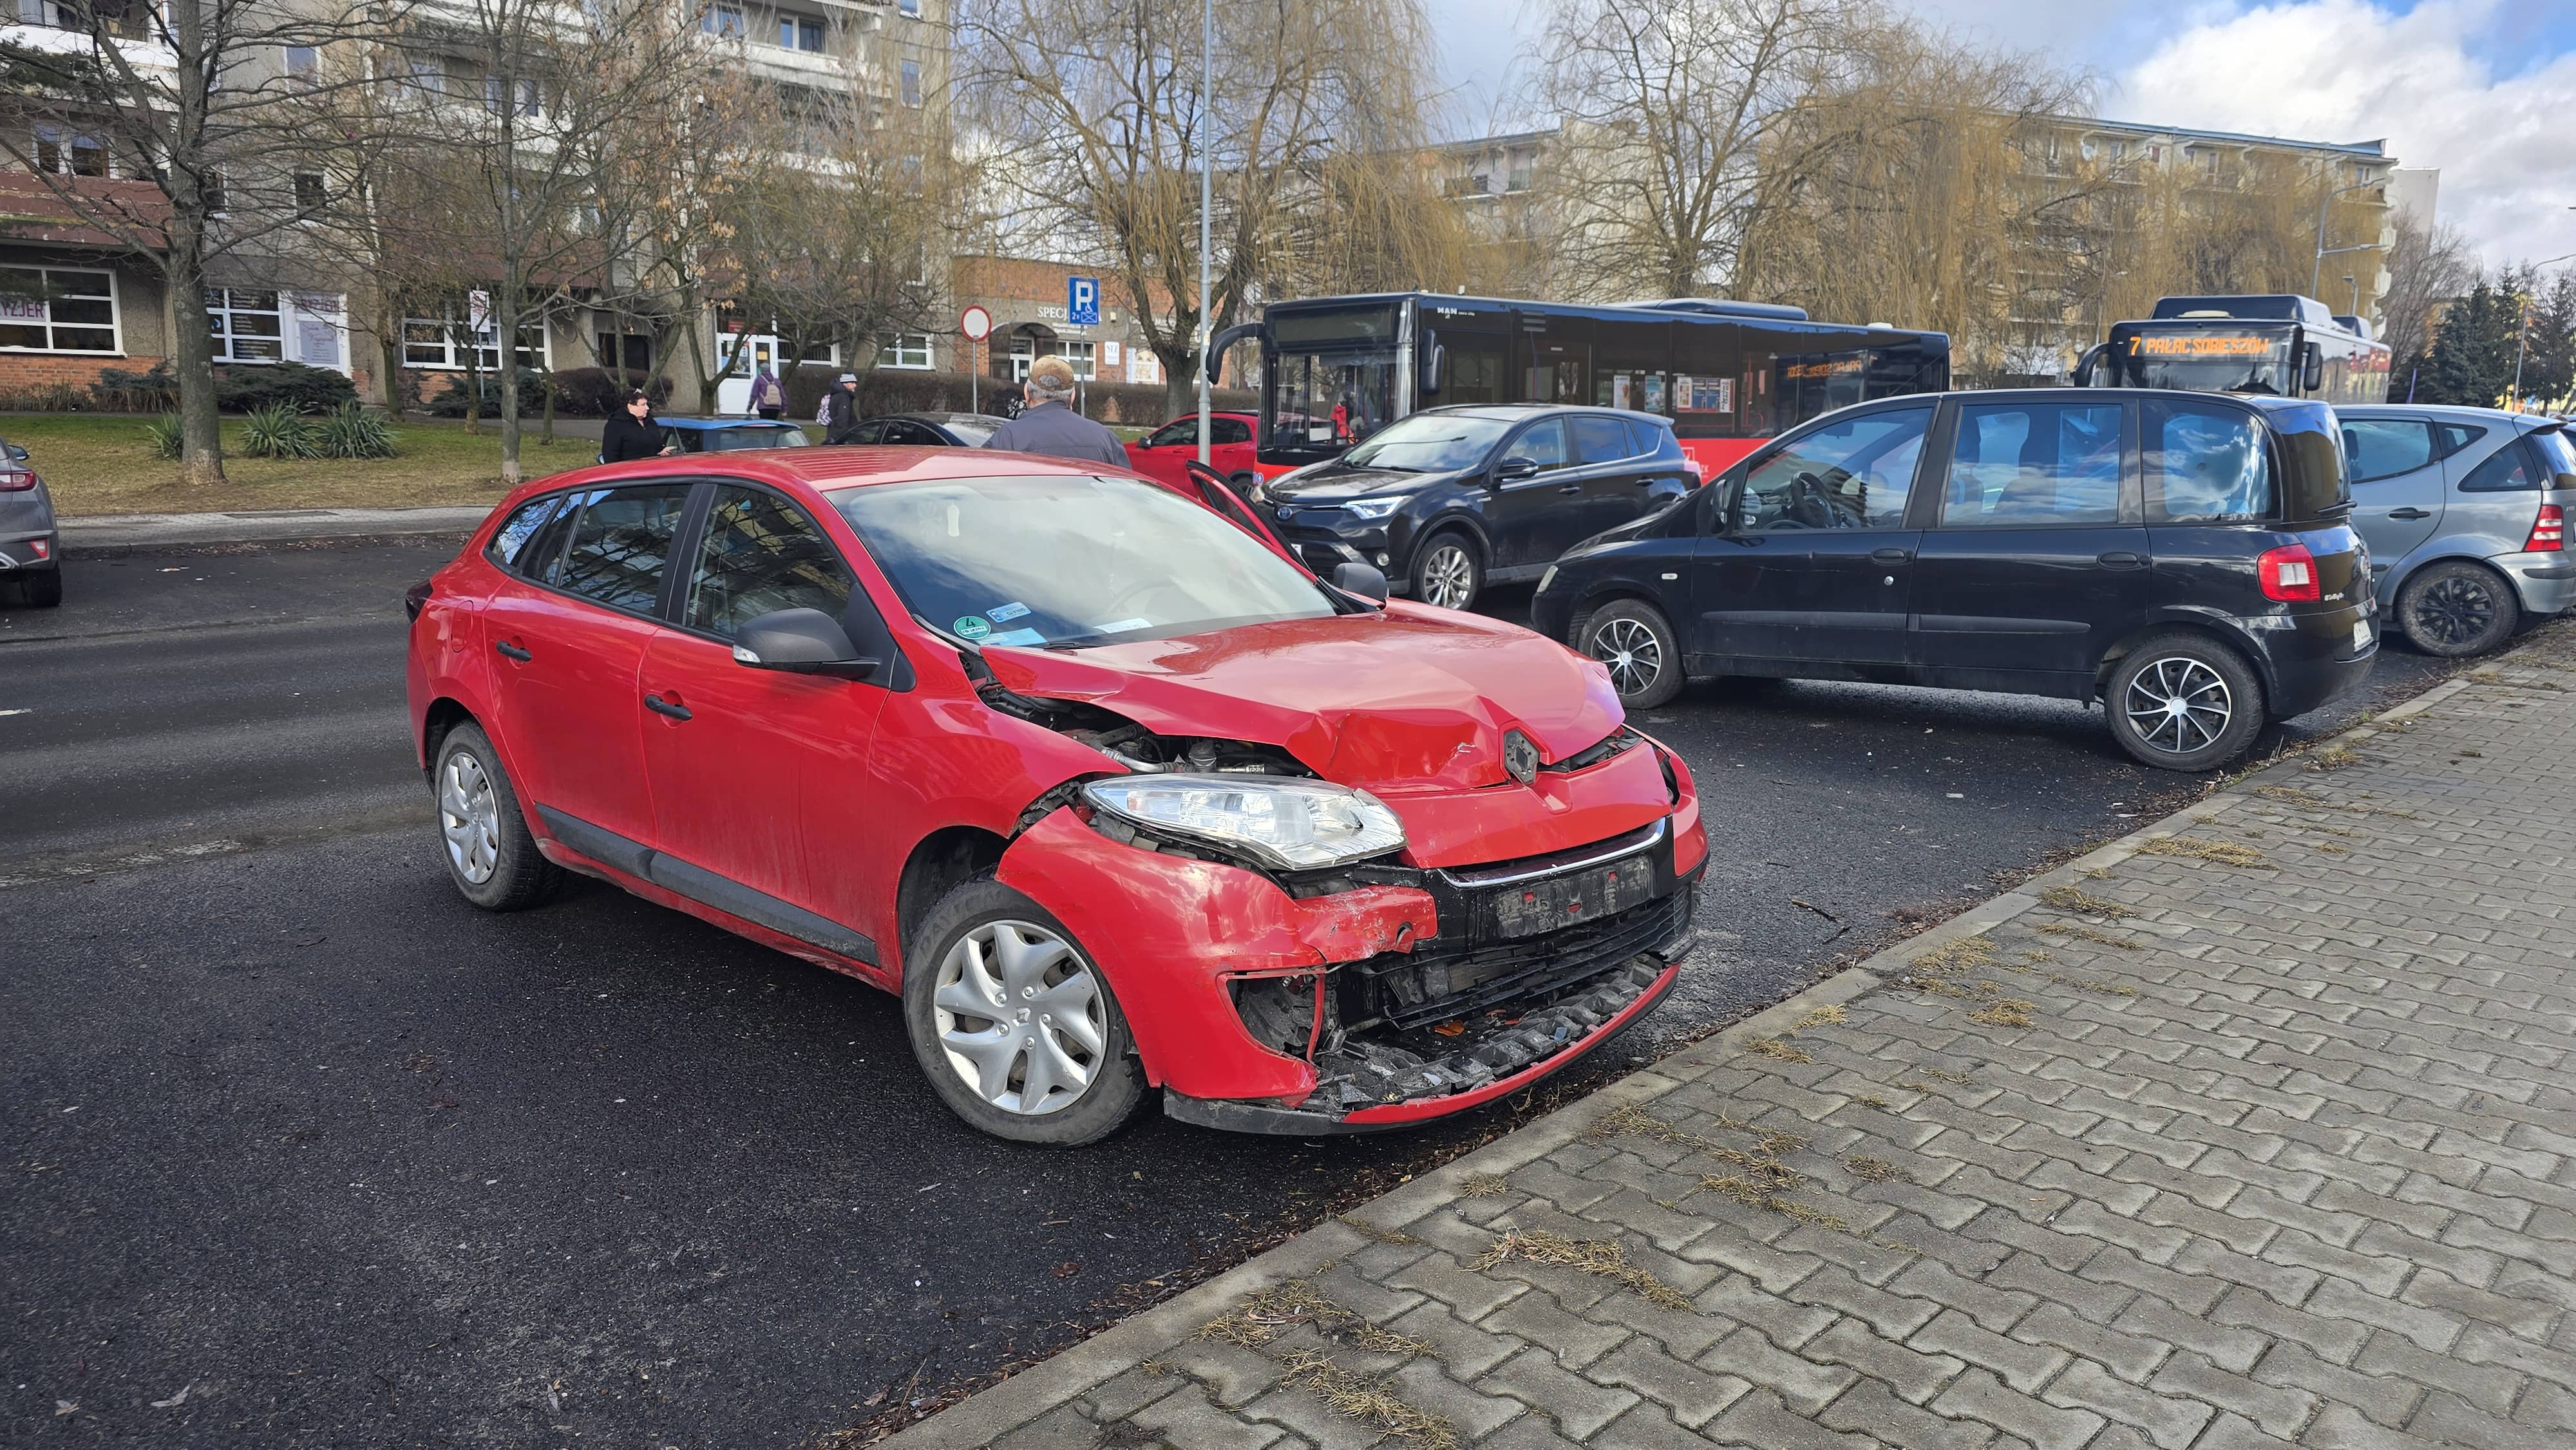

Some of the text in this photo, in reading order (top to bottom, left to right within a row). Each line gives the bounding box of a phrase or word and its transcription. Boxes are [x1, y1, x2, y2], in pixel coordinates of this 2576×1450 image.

[1075, 281, 1094, 311] P
[0, 297, 44, 318] YZJER
[2130, 335, 2269, 355] 7 PAŁAC SOBIESZÓW
[966, 617, 976, 627] 4
